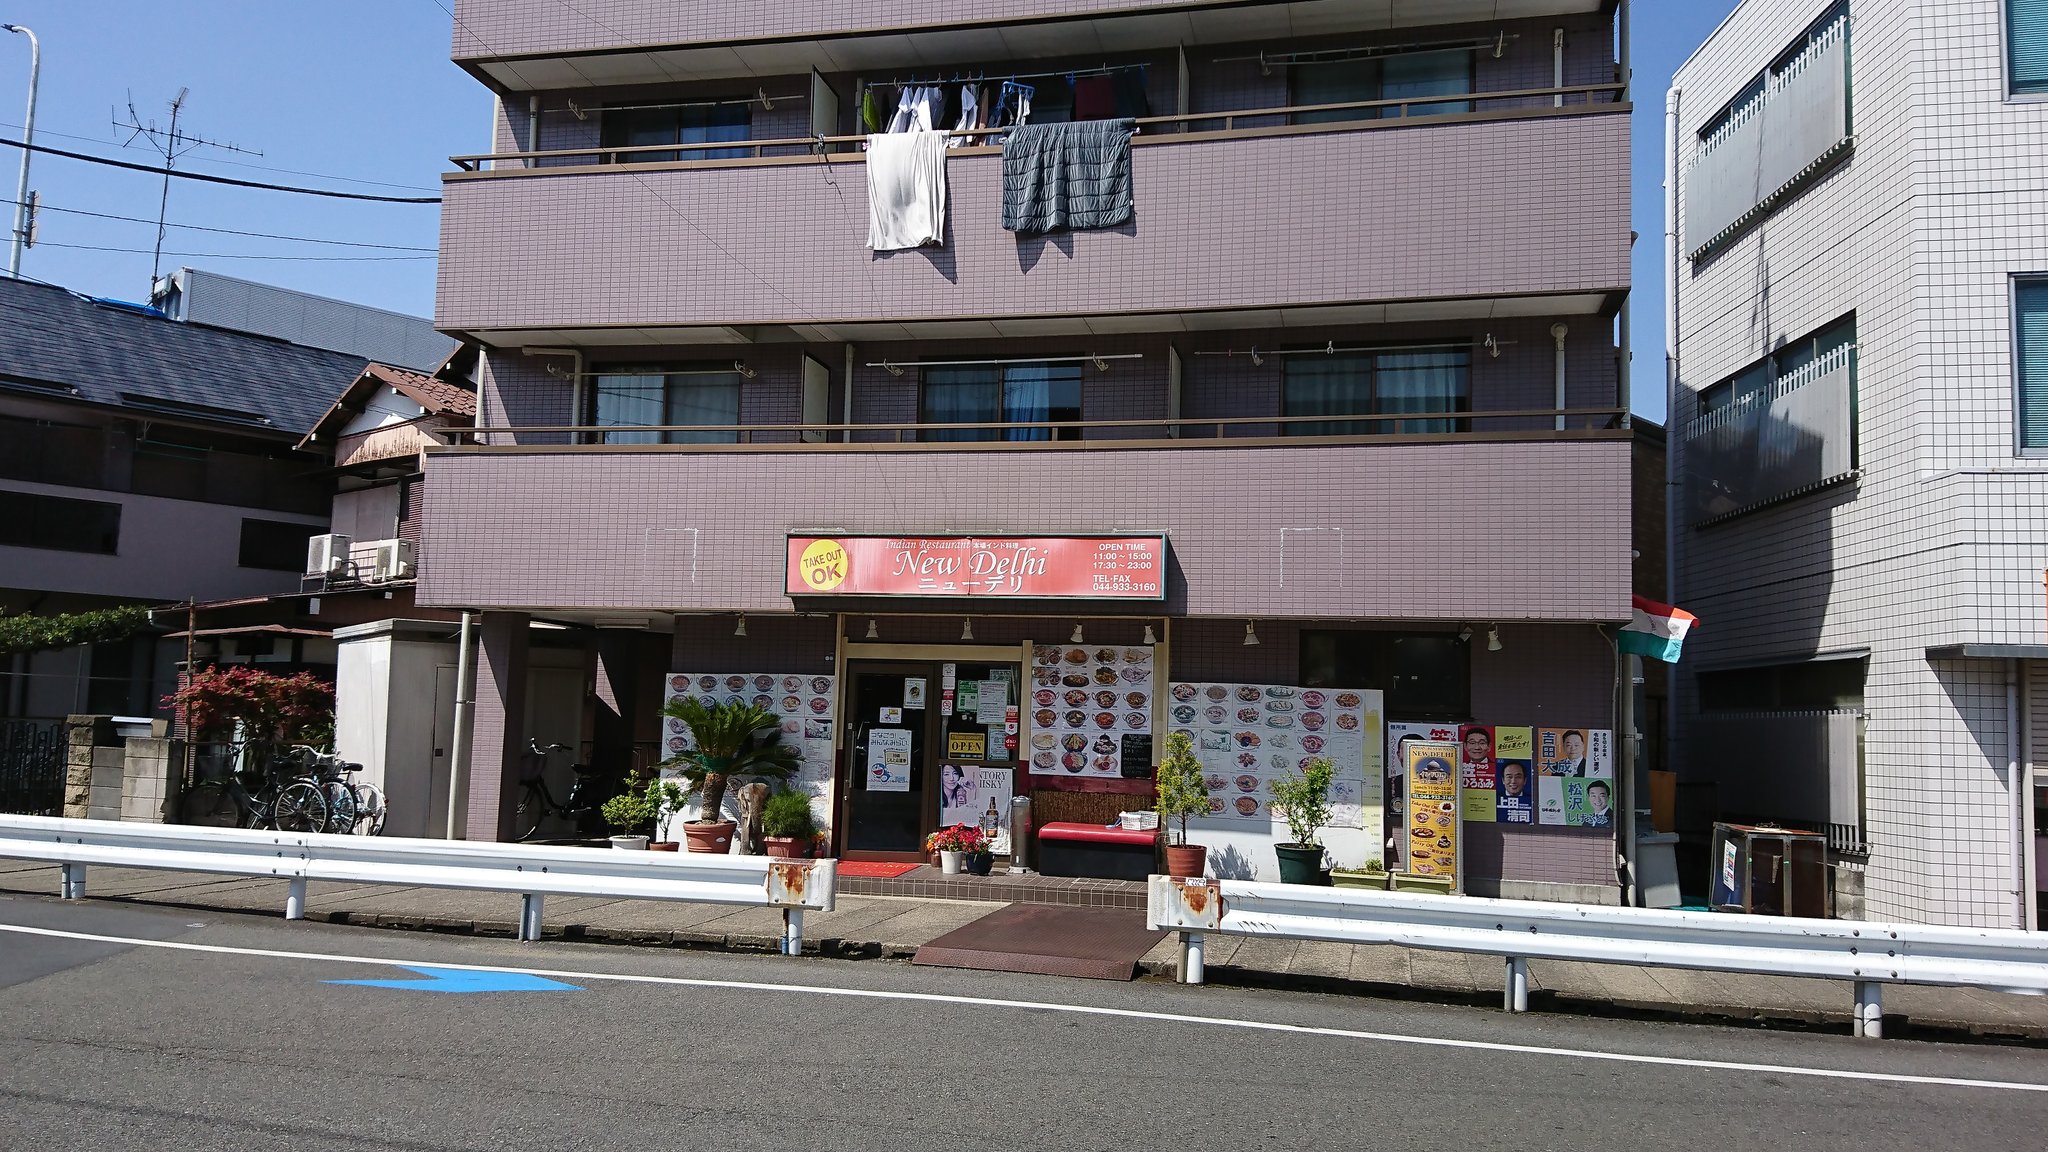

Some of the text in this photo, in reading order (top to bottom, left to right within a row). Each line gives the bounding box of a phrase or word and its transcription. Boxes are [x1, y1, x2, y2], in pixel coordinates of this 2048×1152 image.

[886, 539, 971, 551] Indian Restaurant
[973, 541, 1019, 550] 本場インド料理
[1098, 543, 1146, 551] OPEN TIME
[803, 548, 843, 569] TAKE OUT
[892, 546, 1049, 577] New Delhi
[1093, 552, 1118, 560] 11:00
[1128, 552, 1152, 560] 15:00
[1093, 561, 1117, 570] 17:30
[1127, 561, 1152, 570] 23:00
[811, 562, 843, 585] OK
[918, 574, 1023, 593] ニューデリ
[1093, 583, 1156, 592] 044-933-3160
[1541, 731, 1556, 758] 吉田
[1541, 759, 1573, 773] 大成
[1463, 777, 1495, 789] ひろふみ
[1496, 796, 1519, 809] 上田
[1568, 782, 1583, 810] 松沢
[1507, 809, 1530, 822] 清司
